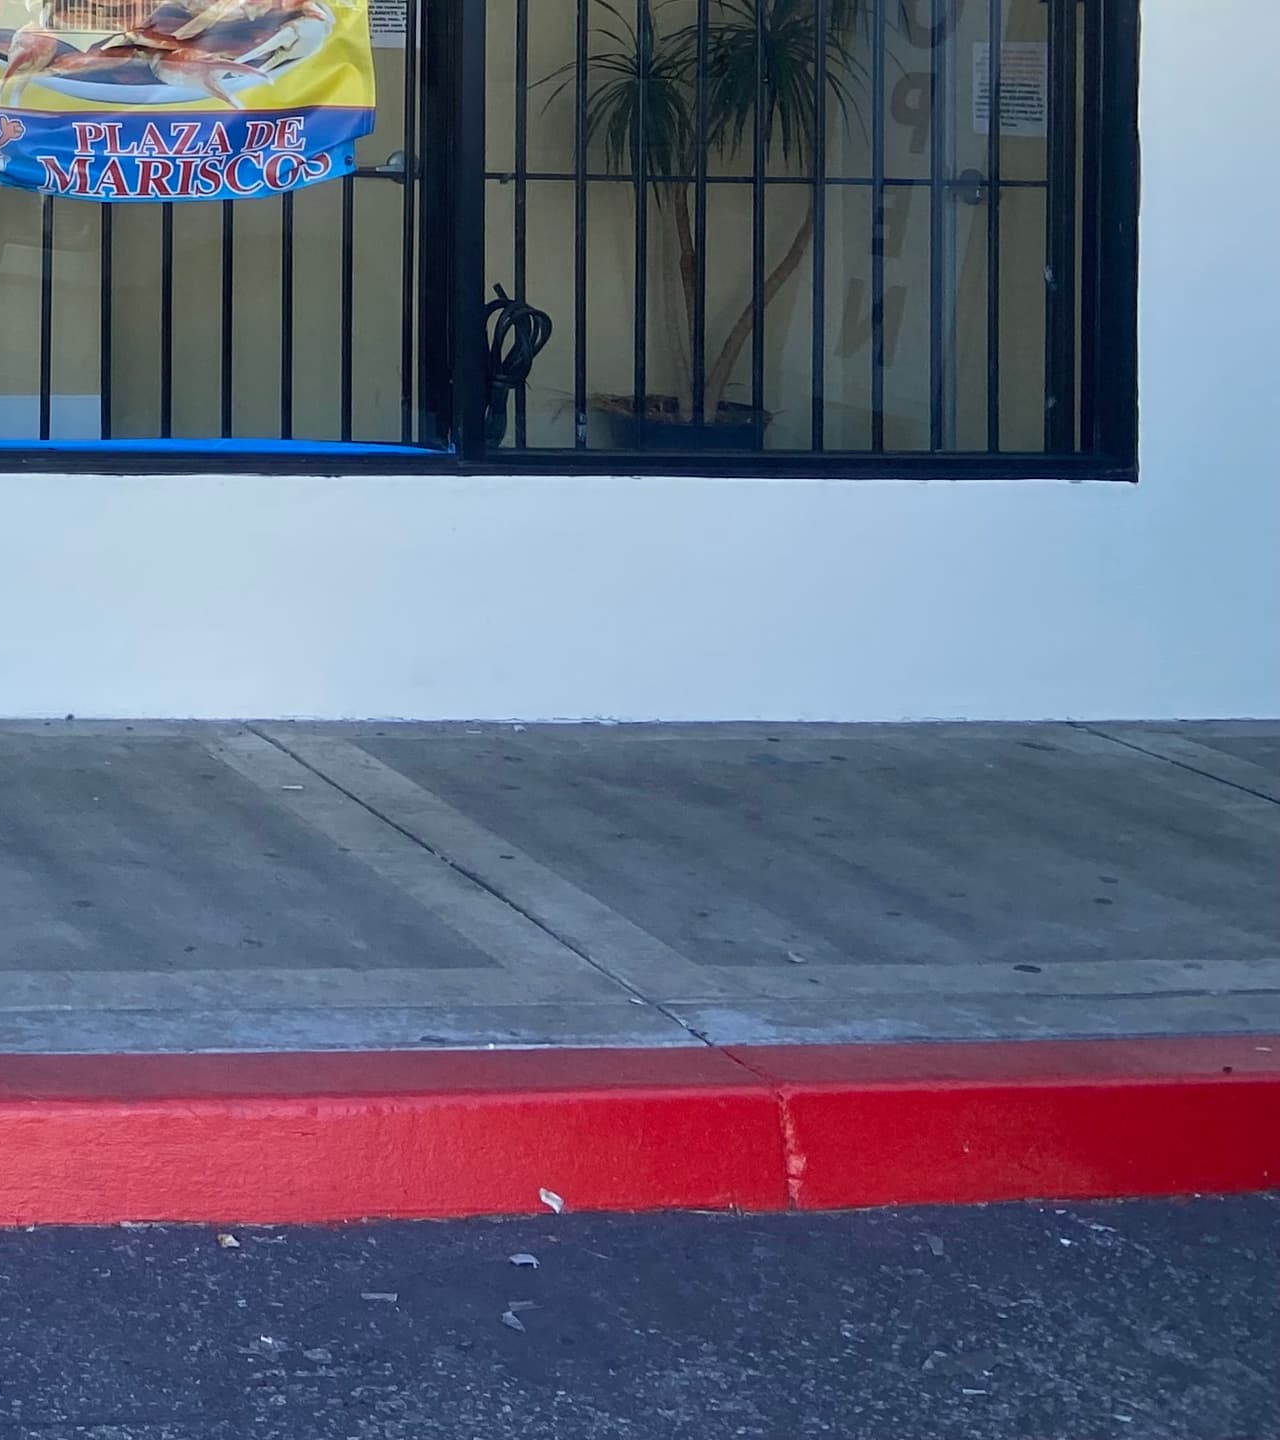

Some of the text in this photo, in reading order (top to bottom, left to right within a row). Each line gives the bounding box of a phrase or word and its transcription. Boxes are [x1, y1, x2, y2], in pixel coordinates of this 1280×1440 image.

[71, 116, 306, 156] PLAZA DE
[37, 151, 331, 198] MARISCOS
